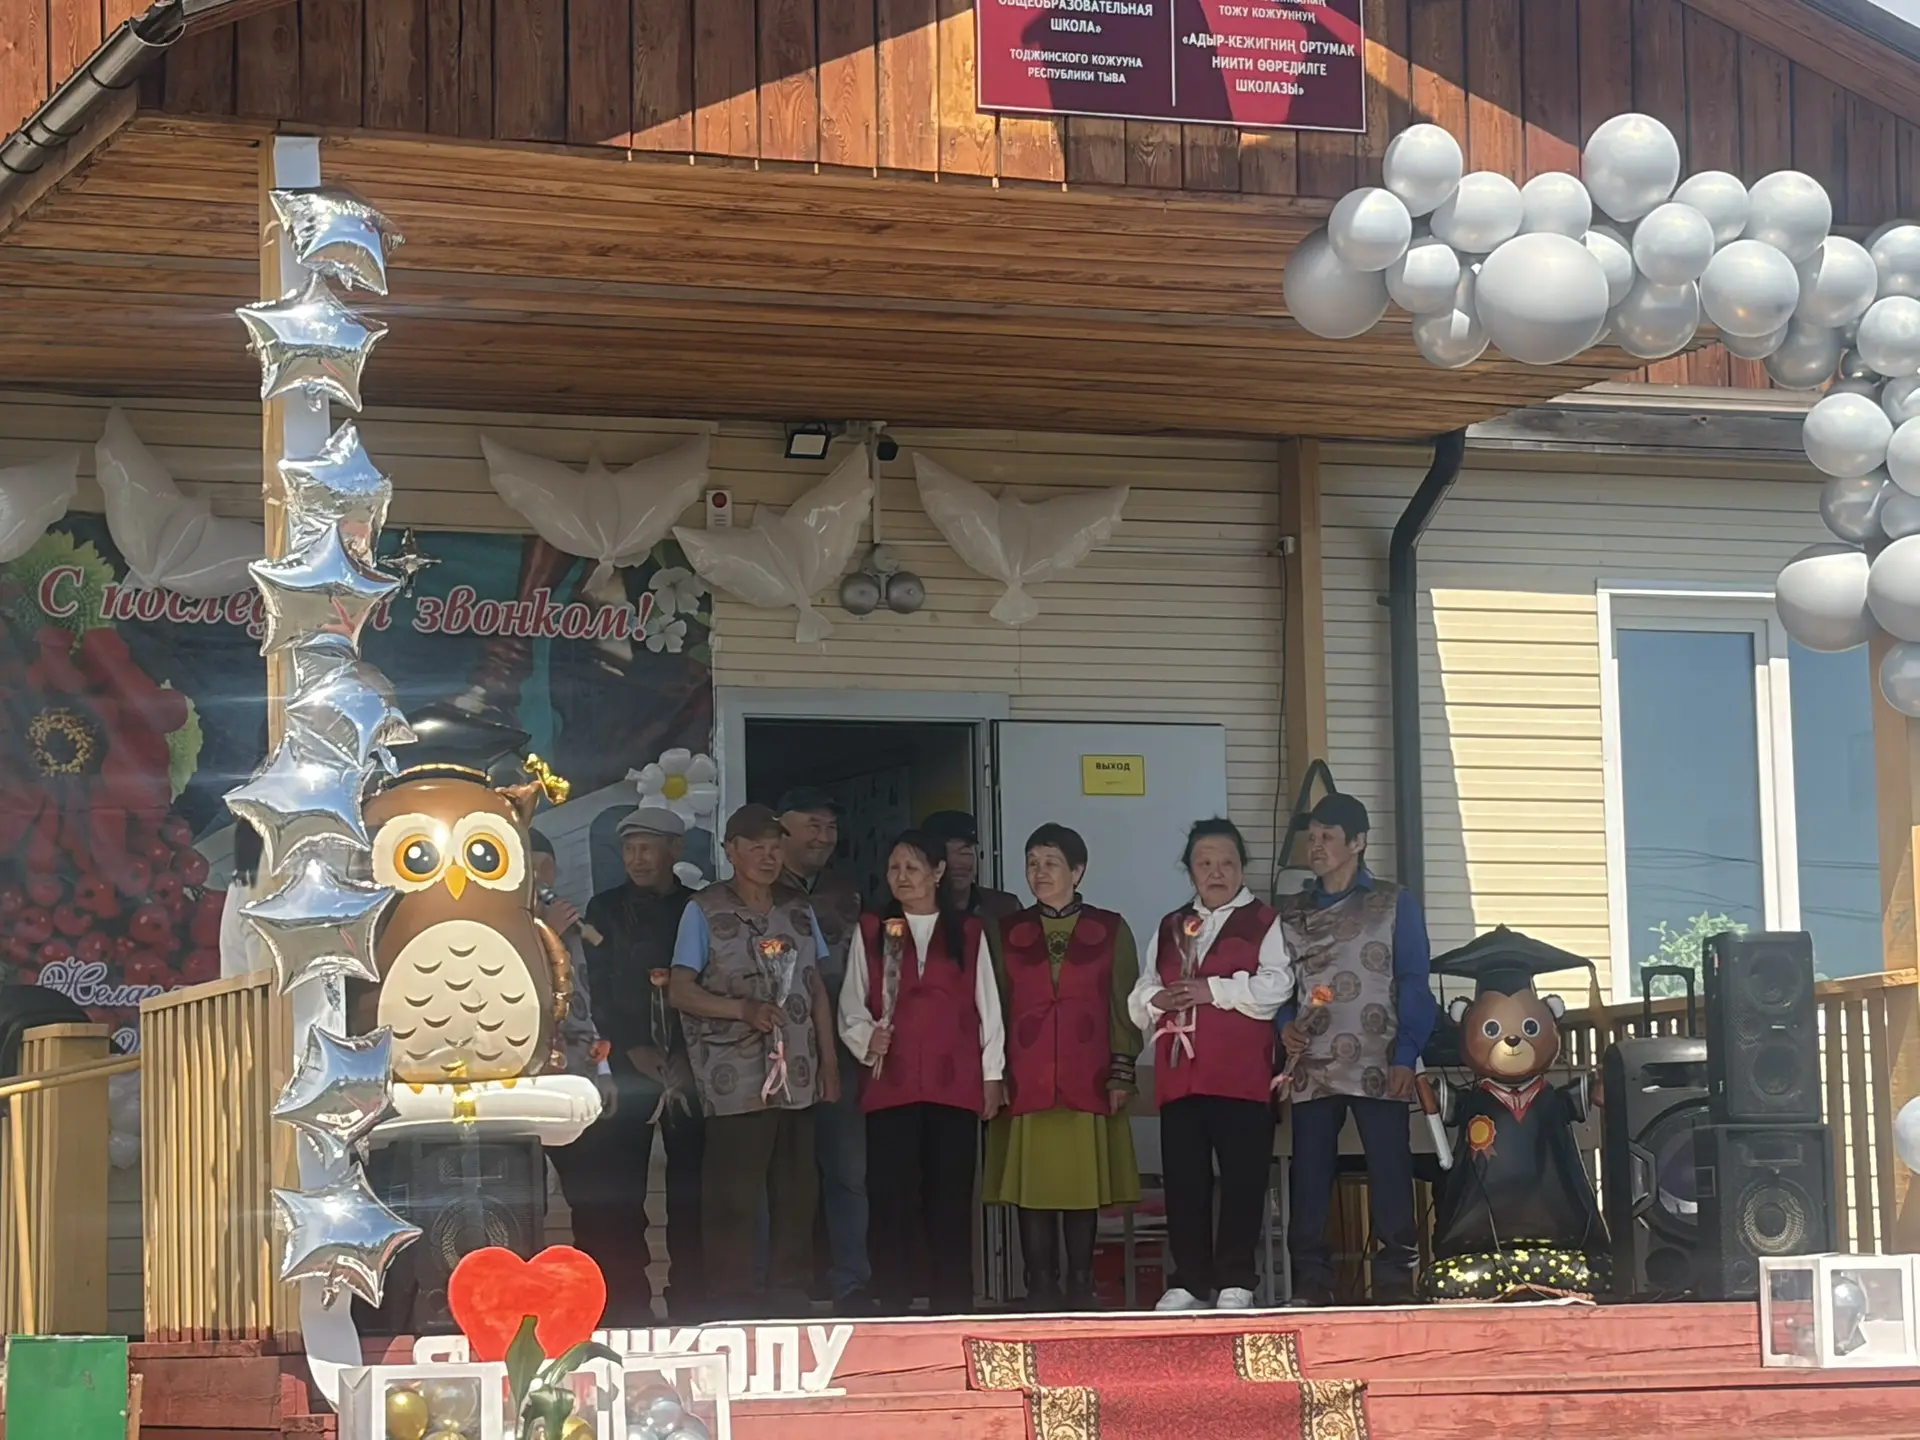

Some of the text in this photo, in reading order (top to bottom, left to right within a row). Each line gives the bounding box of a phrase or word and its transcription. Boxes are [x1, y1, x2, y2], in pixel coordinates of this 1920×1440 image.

[1218, 5, 1316, 24] ТОЖУ КОЖУУННУҢ
[1050, 17, 1102, 34] ШКОЛА»
[1299, 41, 1355, 57] ОРТУМАК
[1009, 48, 1143, 68] ТОДЖИНСКОГО КОЖУУНА
[1212, 56, 1327, 76] НИИТИ ӨӨРЕДИЛГЕ
[1028, 67, 1126, 84] РЕСПУБЛИКИ ТЫВА
[1235, 79, 1304, 95] ШКОЛАЗЫ»
[38, 564, 85, 618] С
[412, 584, 654, 641] звонком!
[1095, 762, 1131, 772] ВЫХОД
